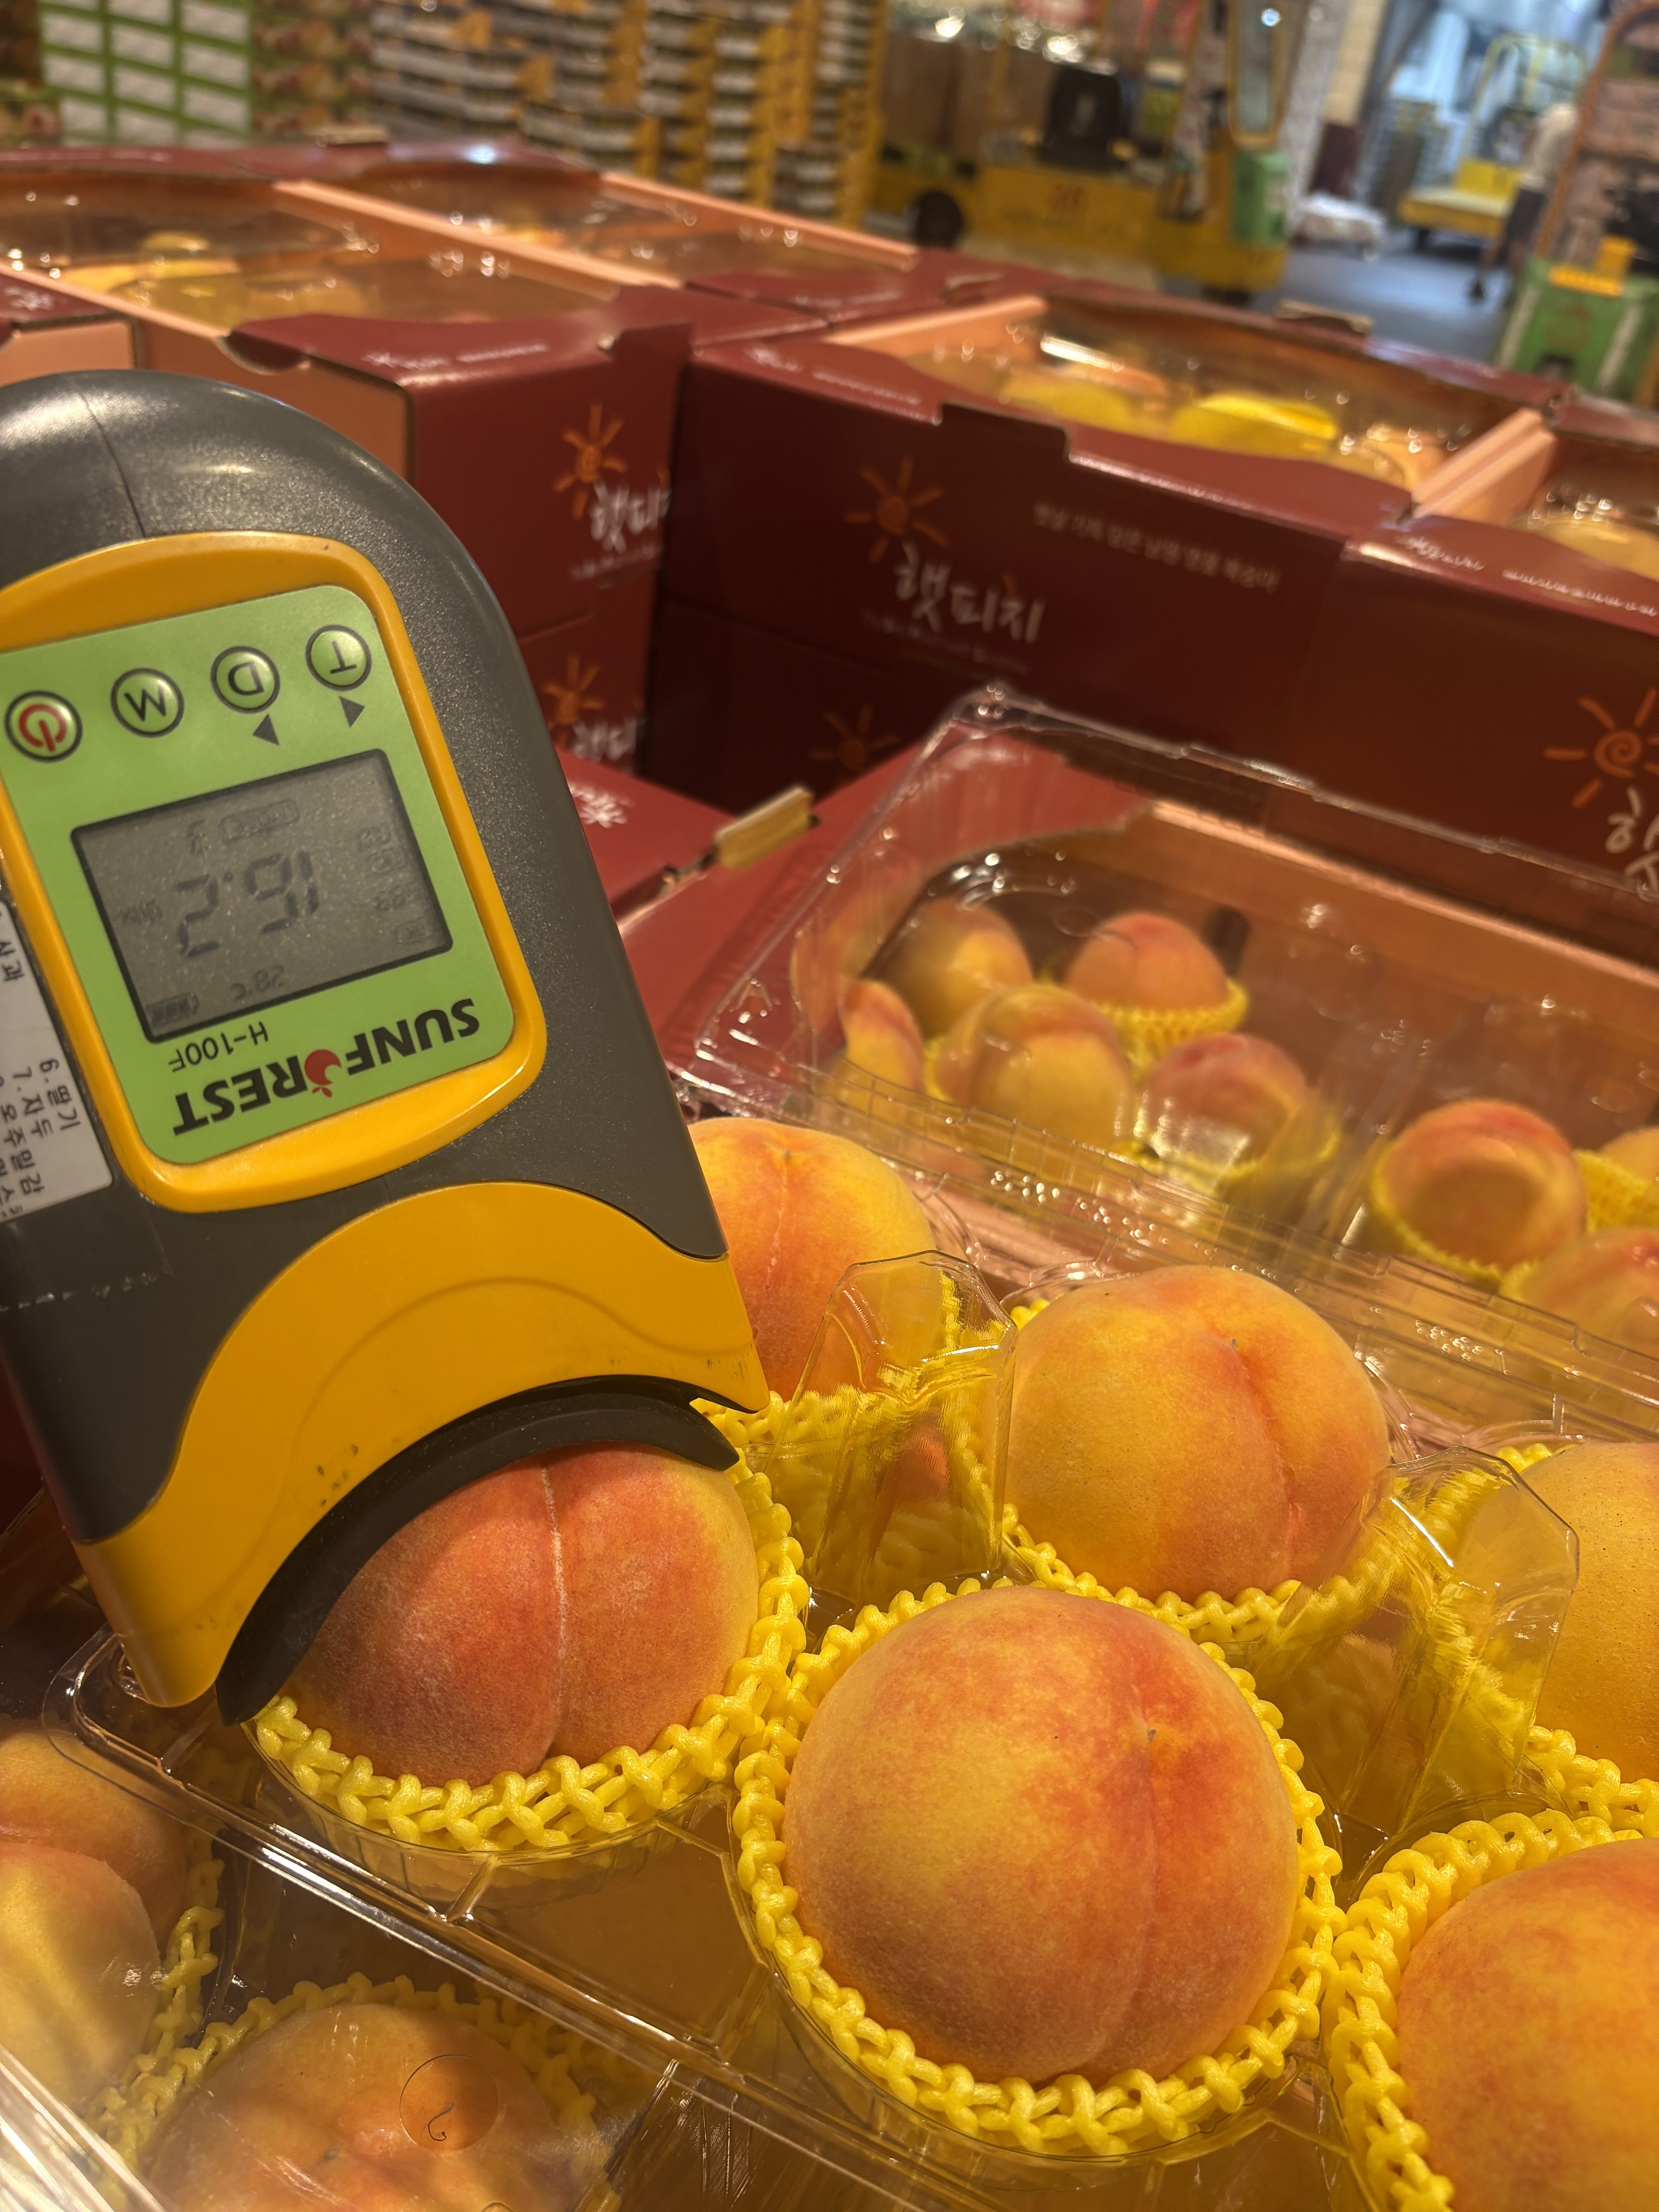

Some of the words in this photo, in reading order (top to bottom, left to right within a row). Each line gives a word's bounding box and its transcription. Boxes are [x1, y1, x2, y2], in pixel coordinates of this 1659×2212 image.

[893, 542, 1047, 644] 햇피치
[228, 661, 265, 696] D
[330, 641, 358, 675] T
[124, 685, 167, 722] M
[174, 851, 320, 957] 16.2
[168, 1021, 269, 1073] H-100F
